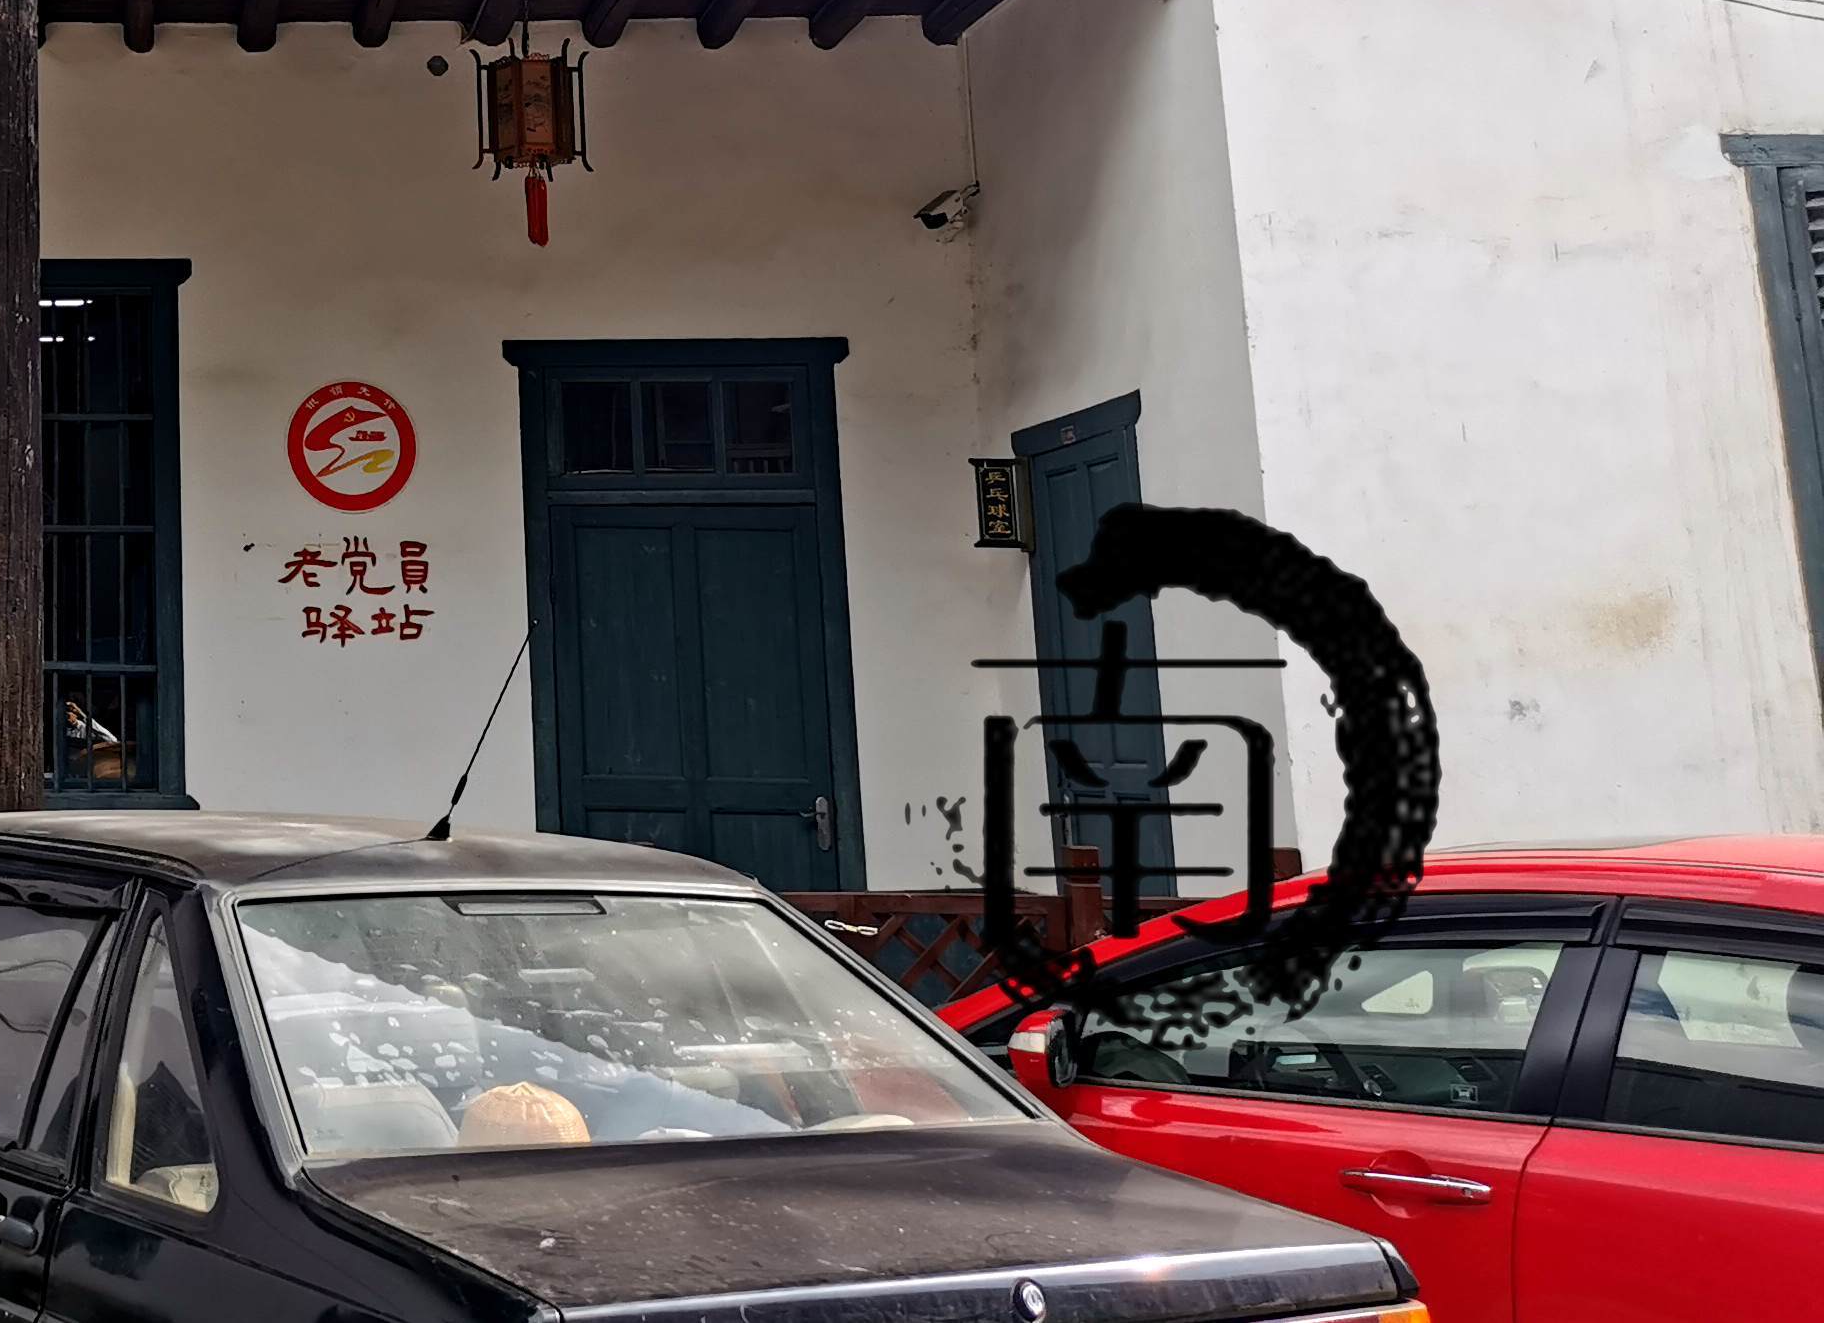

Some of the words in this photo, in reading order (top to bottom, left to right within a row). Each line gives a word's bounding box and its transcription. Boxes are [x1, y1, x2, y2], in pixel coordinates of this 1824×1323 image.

[984, 471, 1012, 535] 乒乓球室
[301, 604, 435, 648] 驿站
